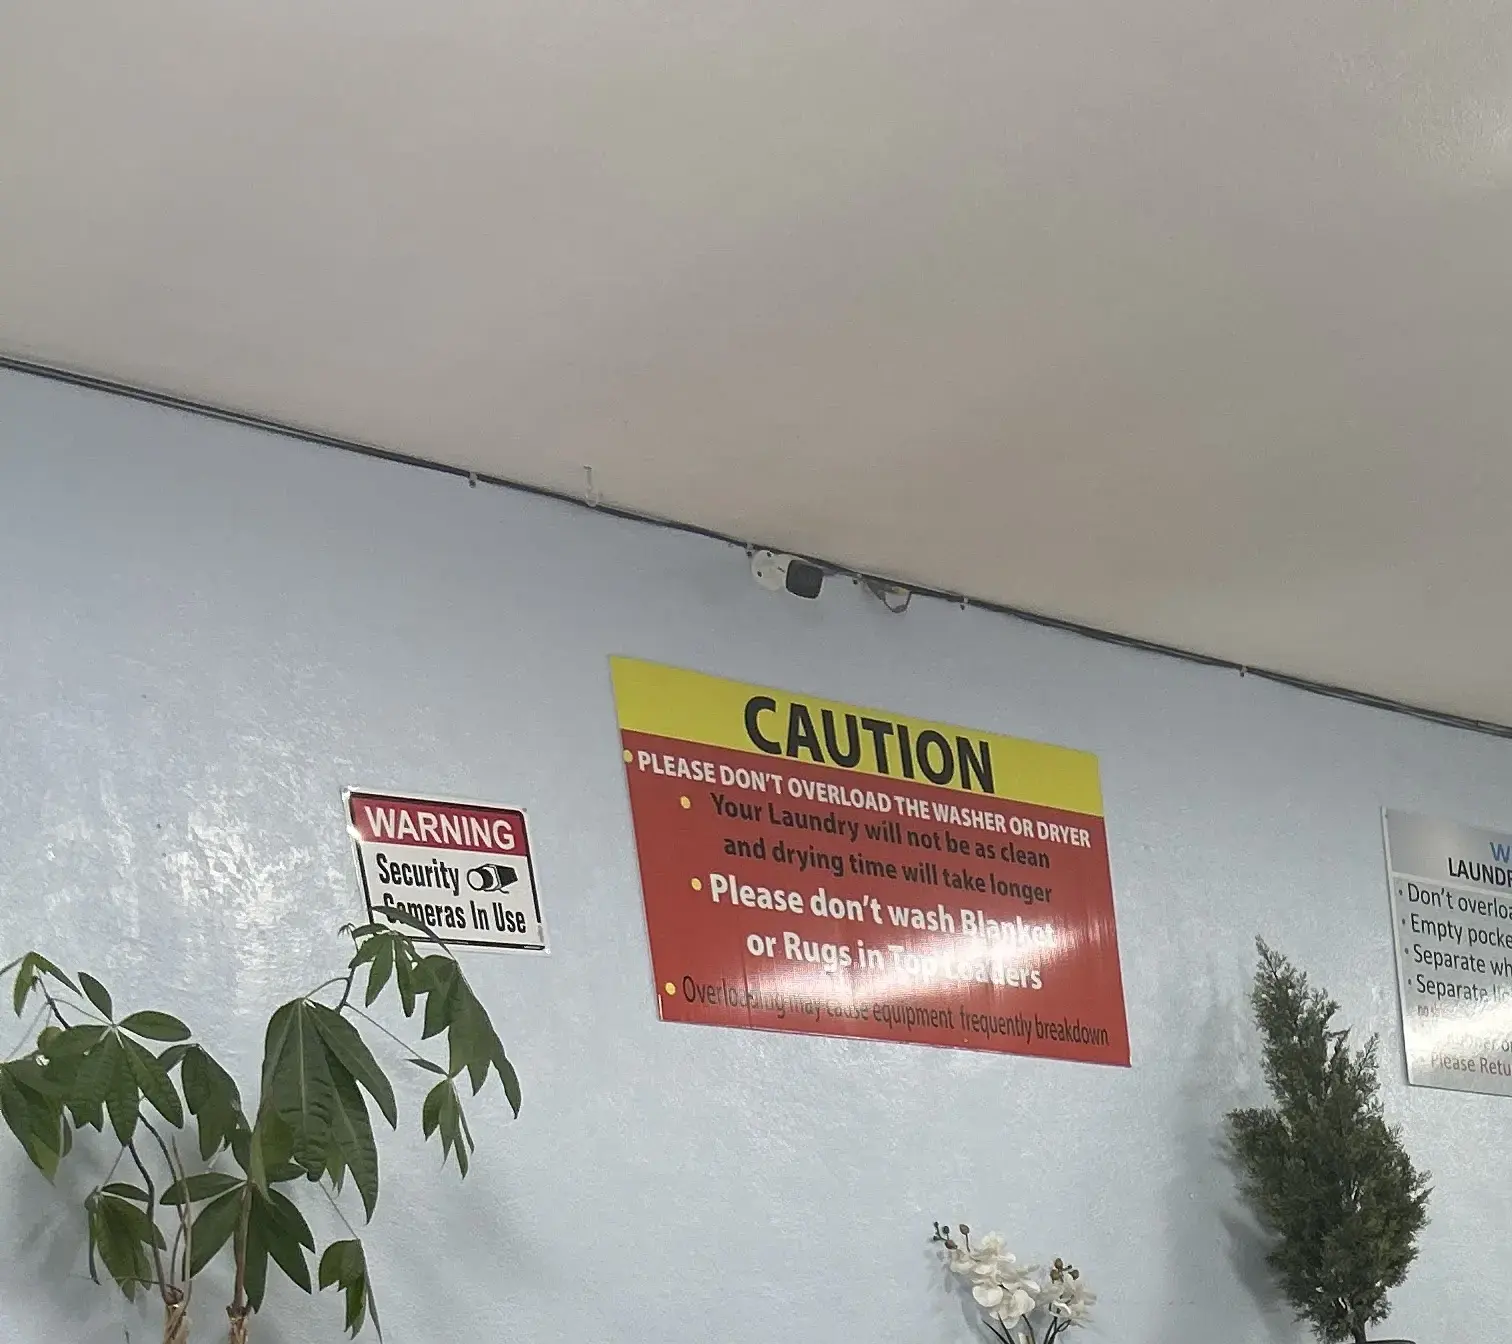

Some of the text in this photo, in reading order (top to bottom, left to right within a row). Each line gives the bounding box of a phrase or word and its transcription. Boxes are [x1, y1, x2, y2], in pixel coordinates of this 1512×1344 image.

[744, 695, 995, 794] CAUTION
[638, 751, 1091, 848] PLEASE DON'T OVERLOAD THE WASHER OR DRYER
[364, 805, 516, 851] WARNING
[710, 792, 1051, 869] Your Laundry will not be as clean
[376, 852, 460, 896] Security
[724, 837, 1052, 905] and drying time will take longer
[470, 900, 490, 931] In
[492, 902, 527, 934] Use
[710, 873, 1057, 948] Please don't wash Blanket
[1407, 882, 1453, 910] Don't
[1410, 913, 1463, 945] Empty
[747, 934, 777, 958] or
[783, 931, 851, 973] Rugs
[857, 940, 884, 970] in
[1413, 944, 1486, 974] Separate
[1416, 973, 1489, 1002] Separate
[873, 1003, 954, 1031] equipment
[960, 1005, 1032, 1045] frequently
[1035, 1014, 1109, 1046] breakdown
[1431, 1053, 1476, 1073] Please
